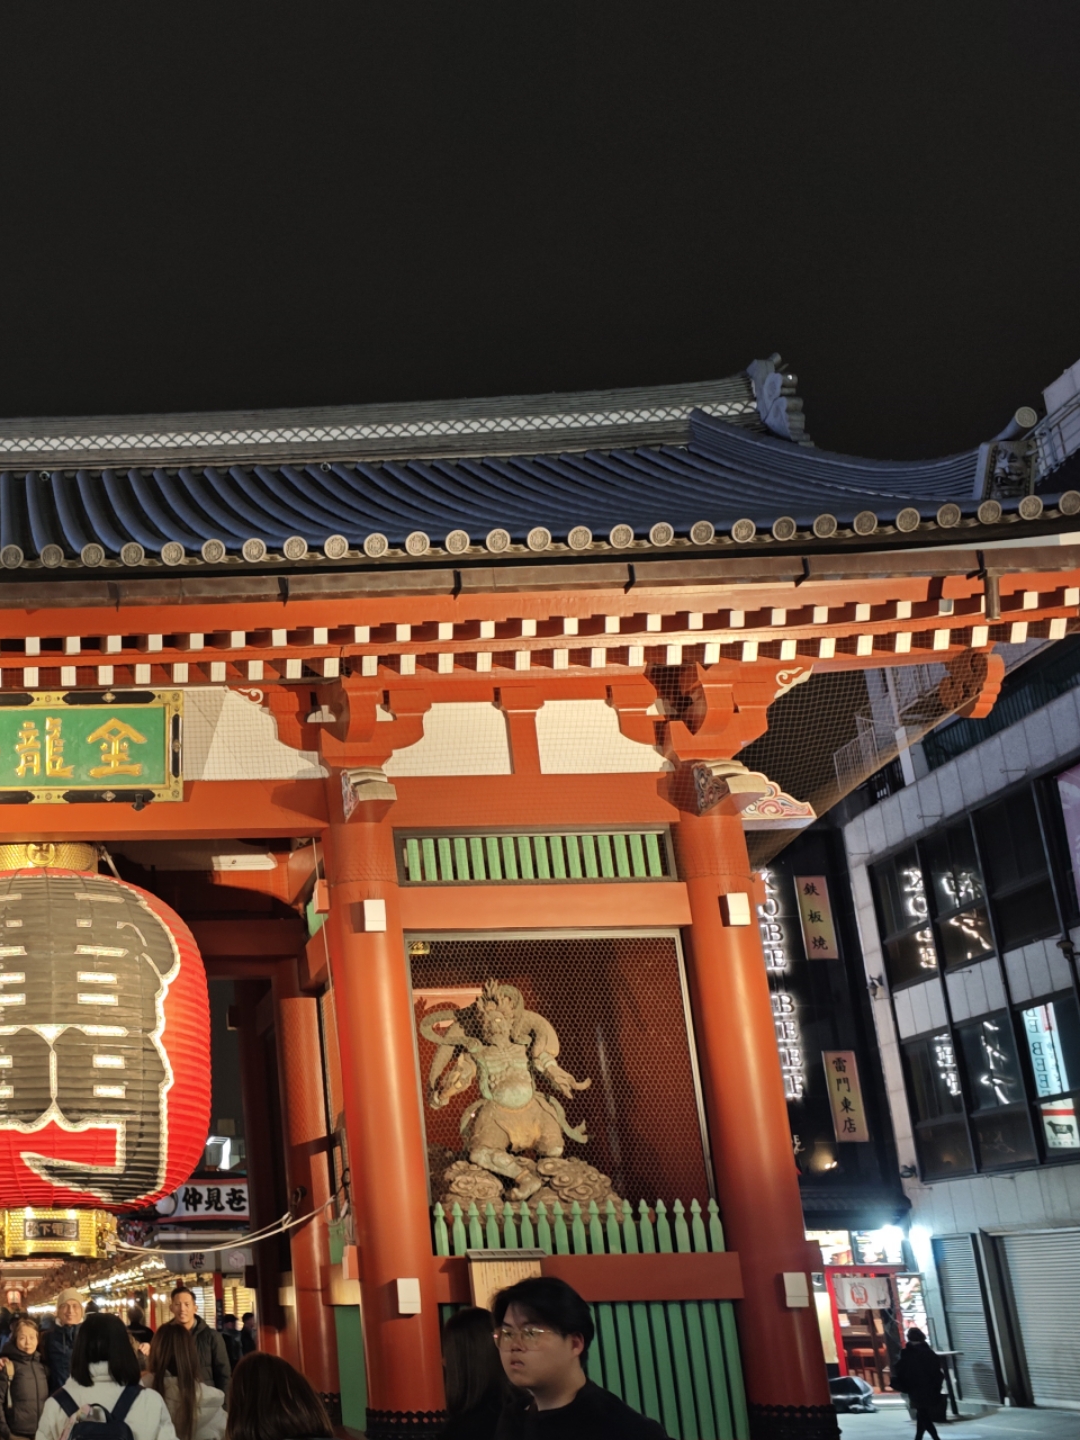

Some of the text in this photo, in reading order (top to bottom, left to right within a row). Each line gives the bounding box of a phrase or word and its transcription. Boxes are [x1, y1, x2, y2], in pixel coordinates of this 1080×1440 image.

[803, 882, 829, 950] 鉄板焼
[770, 994, 804, 1100] BEEF
[831, 1057, 858, 1133] 雷門東店
